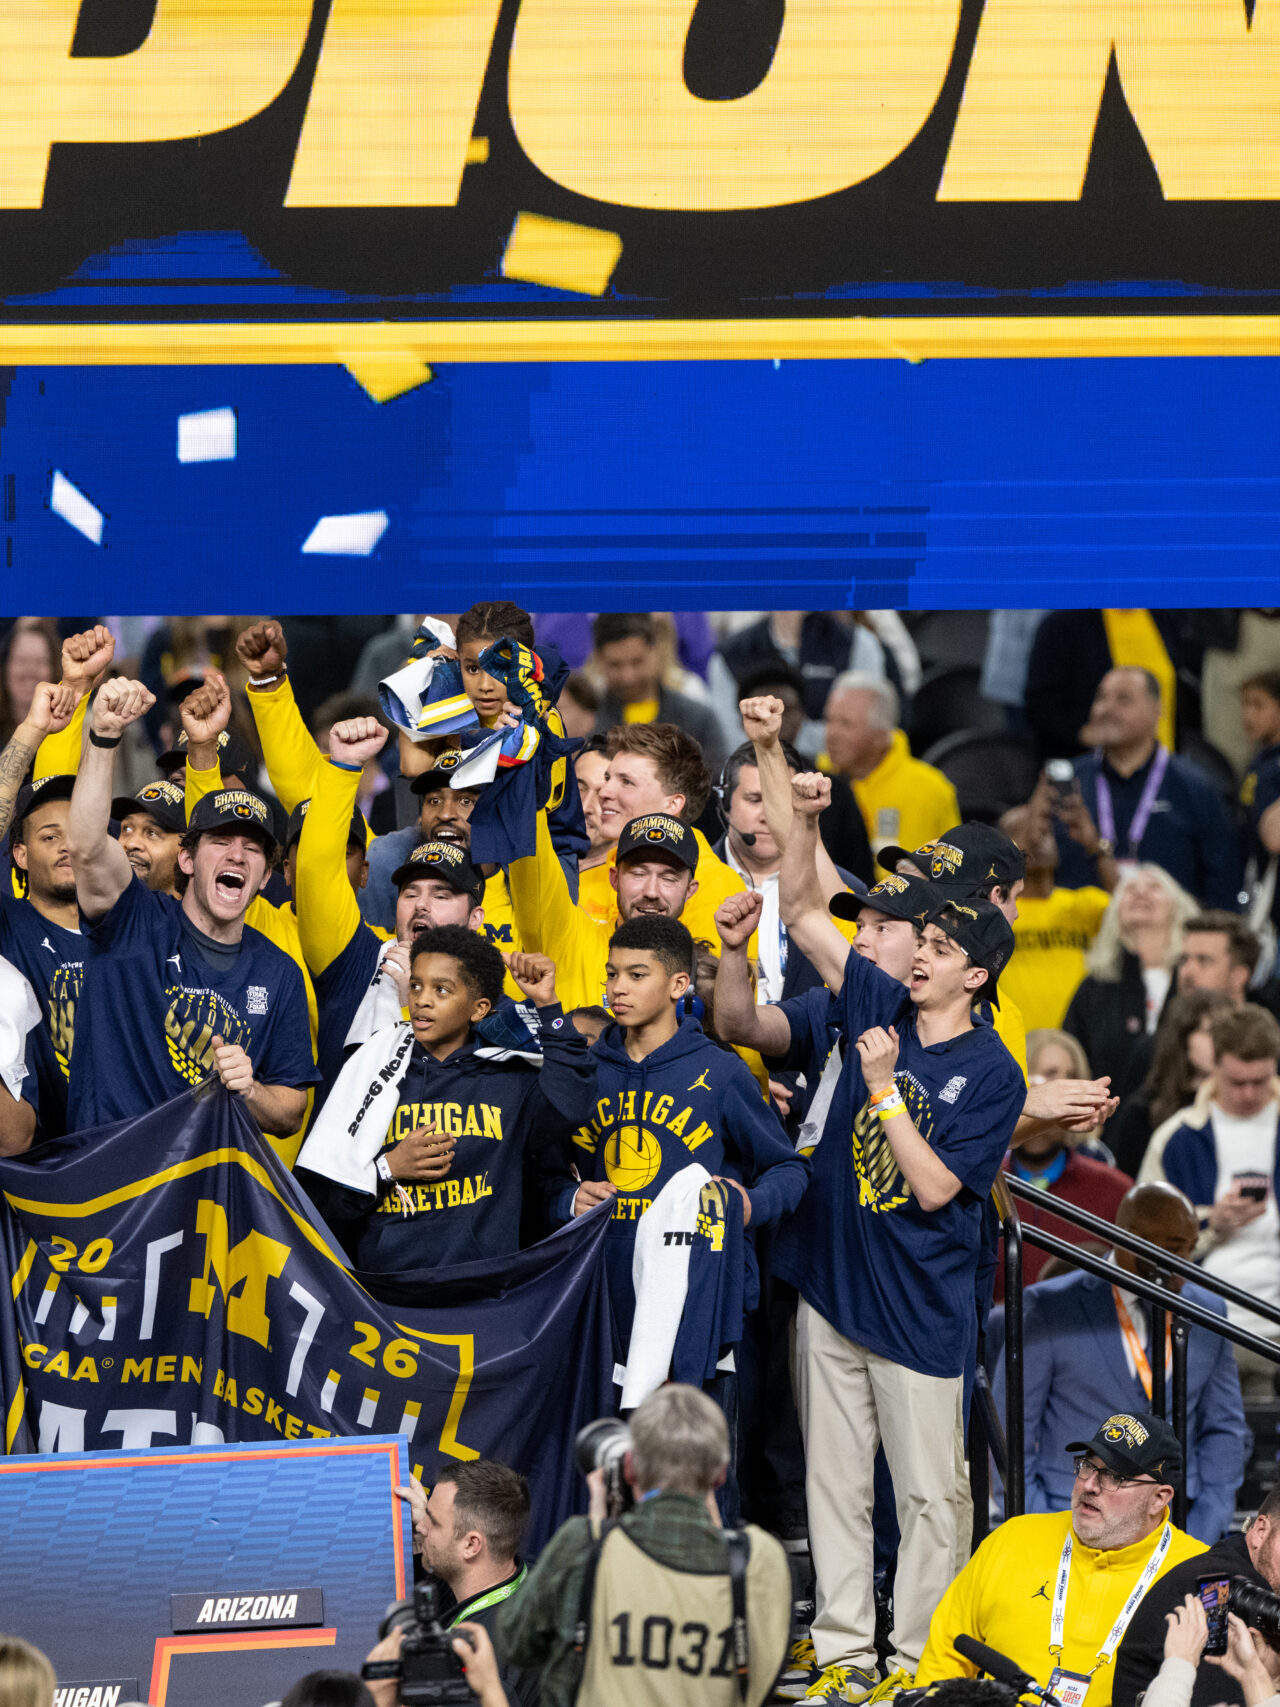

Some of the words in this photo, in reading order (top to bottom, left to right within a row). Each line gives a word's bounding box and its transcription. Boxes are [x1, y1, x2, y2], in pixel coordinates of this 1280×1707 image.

[214, 793, 267, 819] CHAMPIONS
[237, 806, 250, 816] M
[630, 818, 685, 841] CHAMPIONS
[648, 831, 663, 839] M
[410, 843, 465, 865] CHAMPIONS
[427, 853, 441, 862] M
[483, 923, 513, 943] M
[347, 1080, 384, 1138] 2026
[572, 1090, 714, 1155] MICHIGAN
[382, 1102, 503, 1147] ICHIGAN
[48, 1234, 114, 1274] 20
[188, 1199, 292, 1350] M
[348, 1320, 420, 1379] 26
[212, 1369, 340, 1441] BASKET
[196, 1595, 278, 1623] ARIZONA
[610, 1611, 737, 1678] 1031
[52, 1685, 121, 1707] HIGAN
